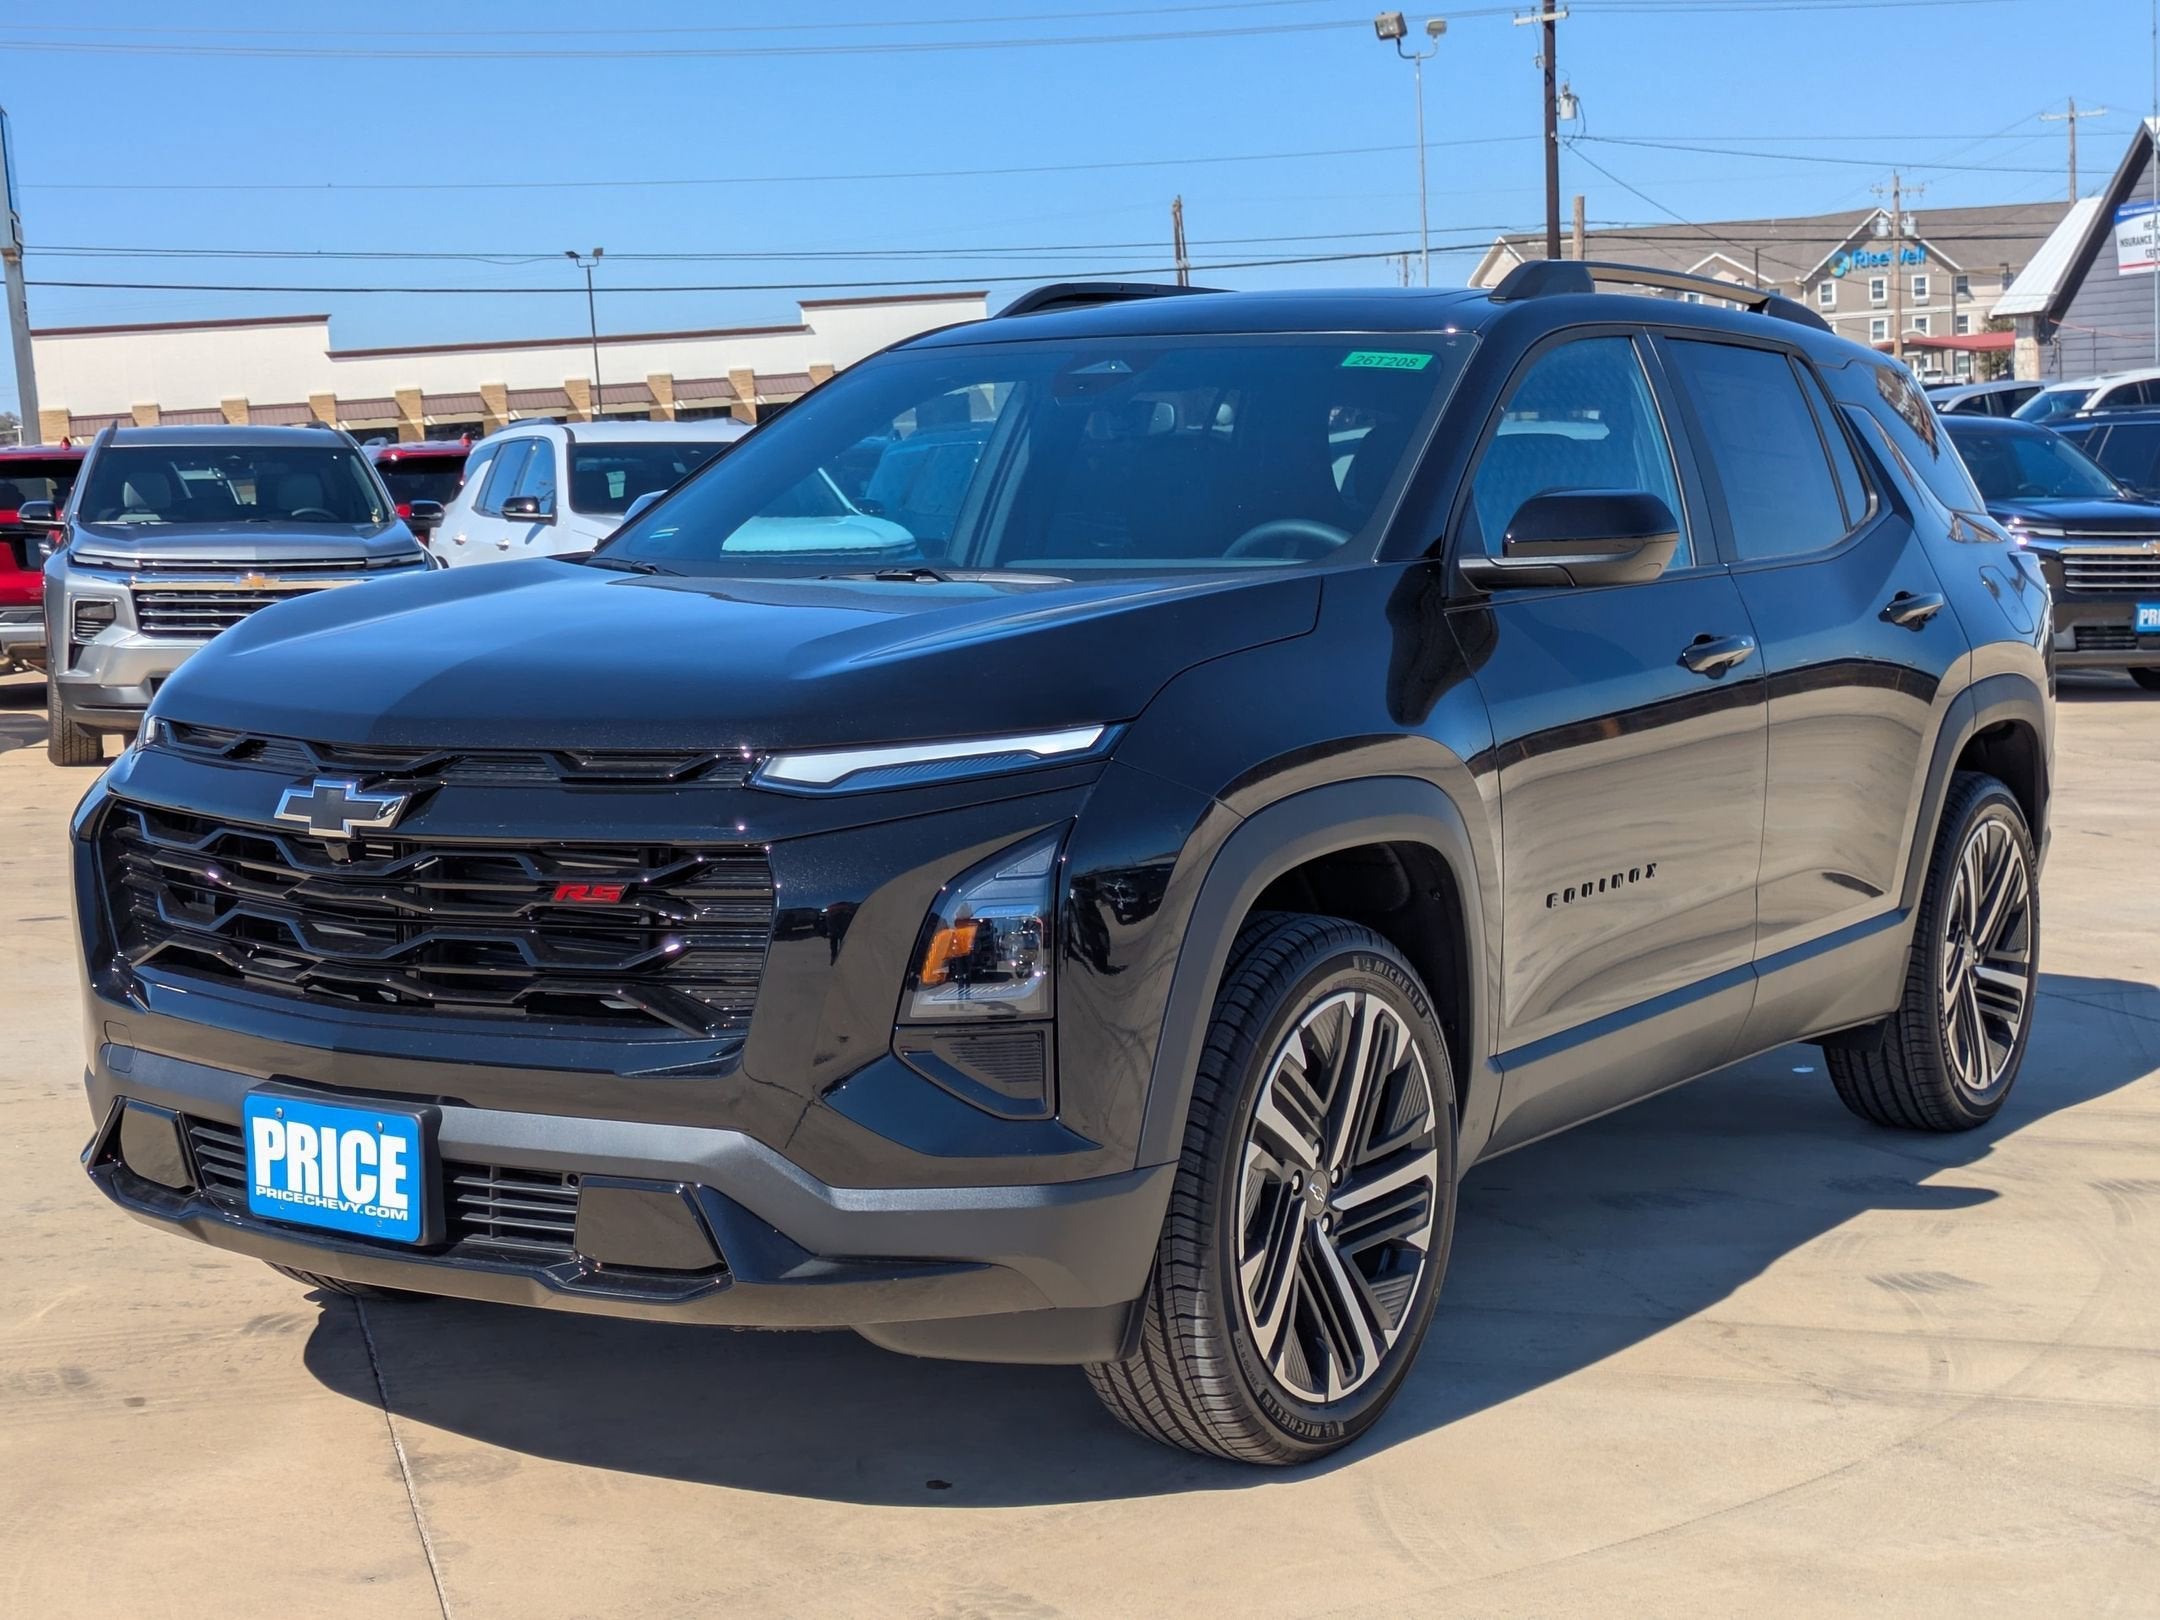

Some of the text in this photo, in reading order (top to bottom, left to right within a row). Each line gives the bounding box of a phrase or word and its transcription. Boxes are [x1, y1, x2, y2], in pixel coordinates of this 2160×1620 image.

[1351, 355, 1419, 367] 26T208
[553, 883, 626, 904] RS
[1545, 862, 1657, 909] EQUINOX
[1373, 960, 1426, 1014] MICHELIN
[252, 1116, 409, 1210] PRICE
[255, 1184, 409, 1222] PRICECHEVY.COM
[1262, 1393, 1321, 1437] MICHELIN
